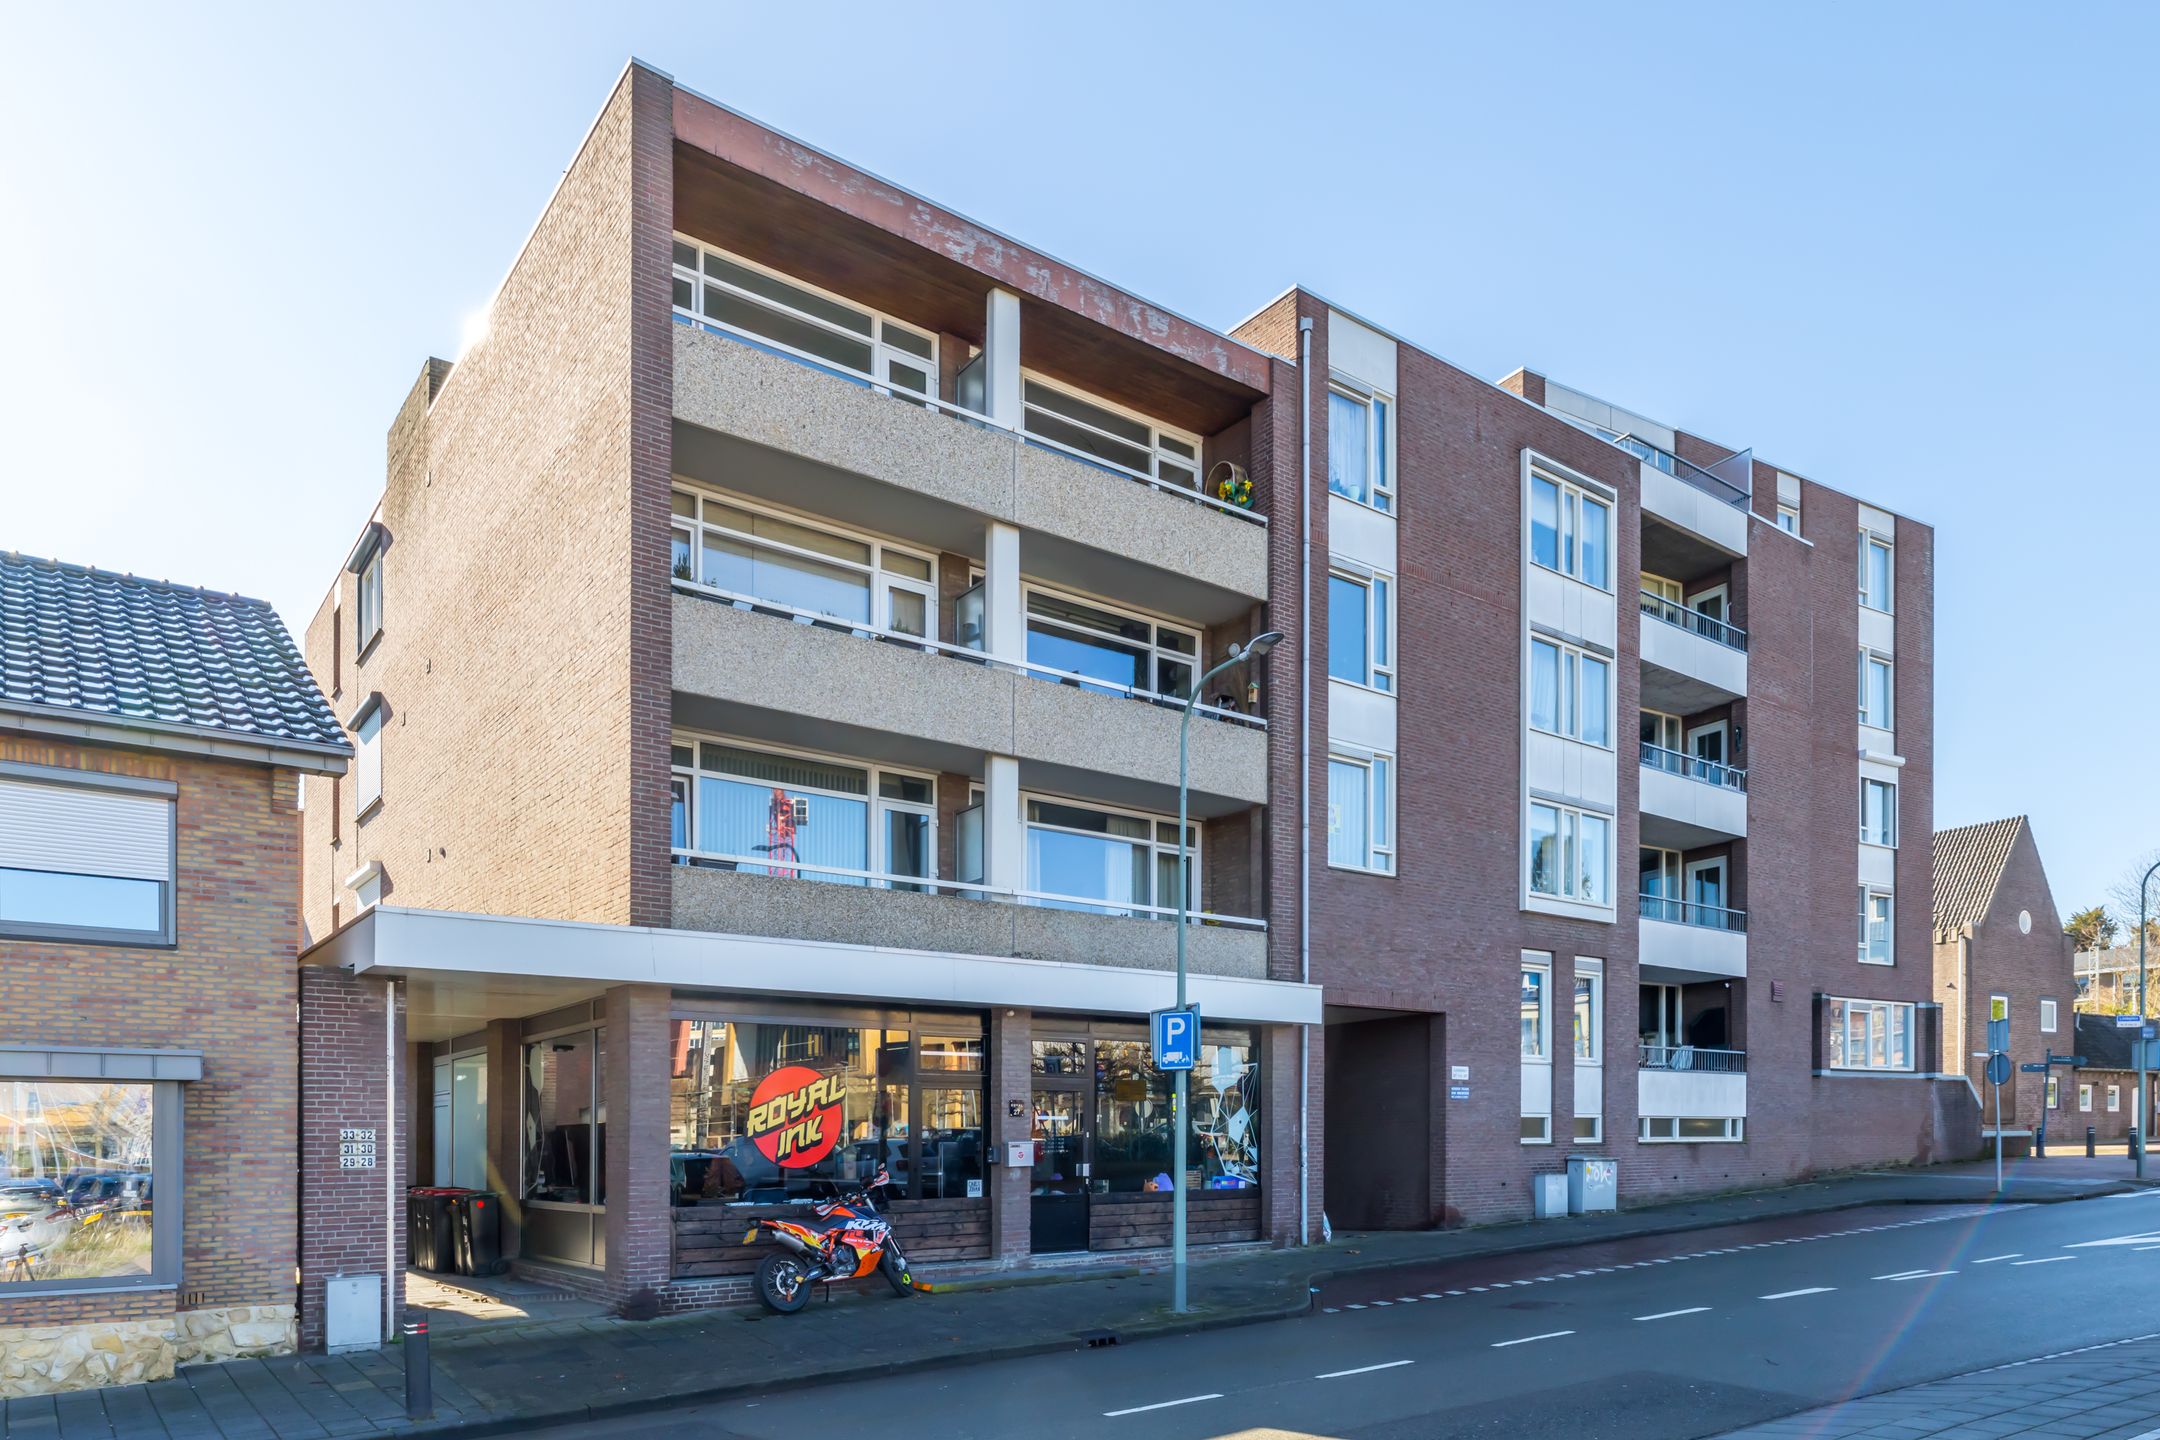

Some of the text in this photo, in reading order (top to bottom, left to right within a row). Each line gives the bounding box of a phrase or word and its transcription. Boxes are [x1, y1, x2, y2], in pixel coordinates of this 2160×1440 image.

[1167, 1017, 1186, 1045] P
[747, 1074, 847, 1137] ROYAL
[343, 1130, 373, 1140] 33 32
[344, 1144, 373, 1154] 31 30
[343, 1158, 373, 1167] 29 28
[845, 1218, 887, 1232] KTM
